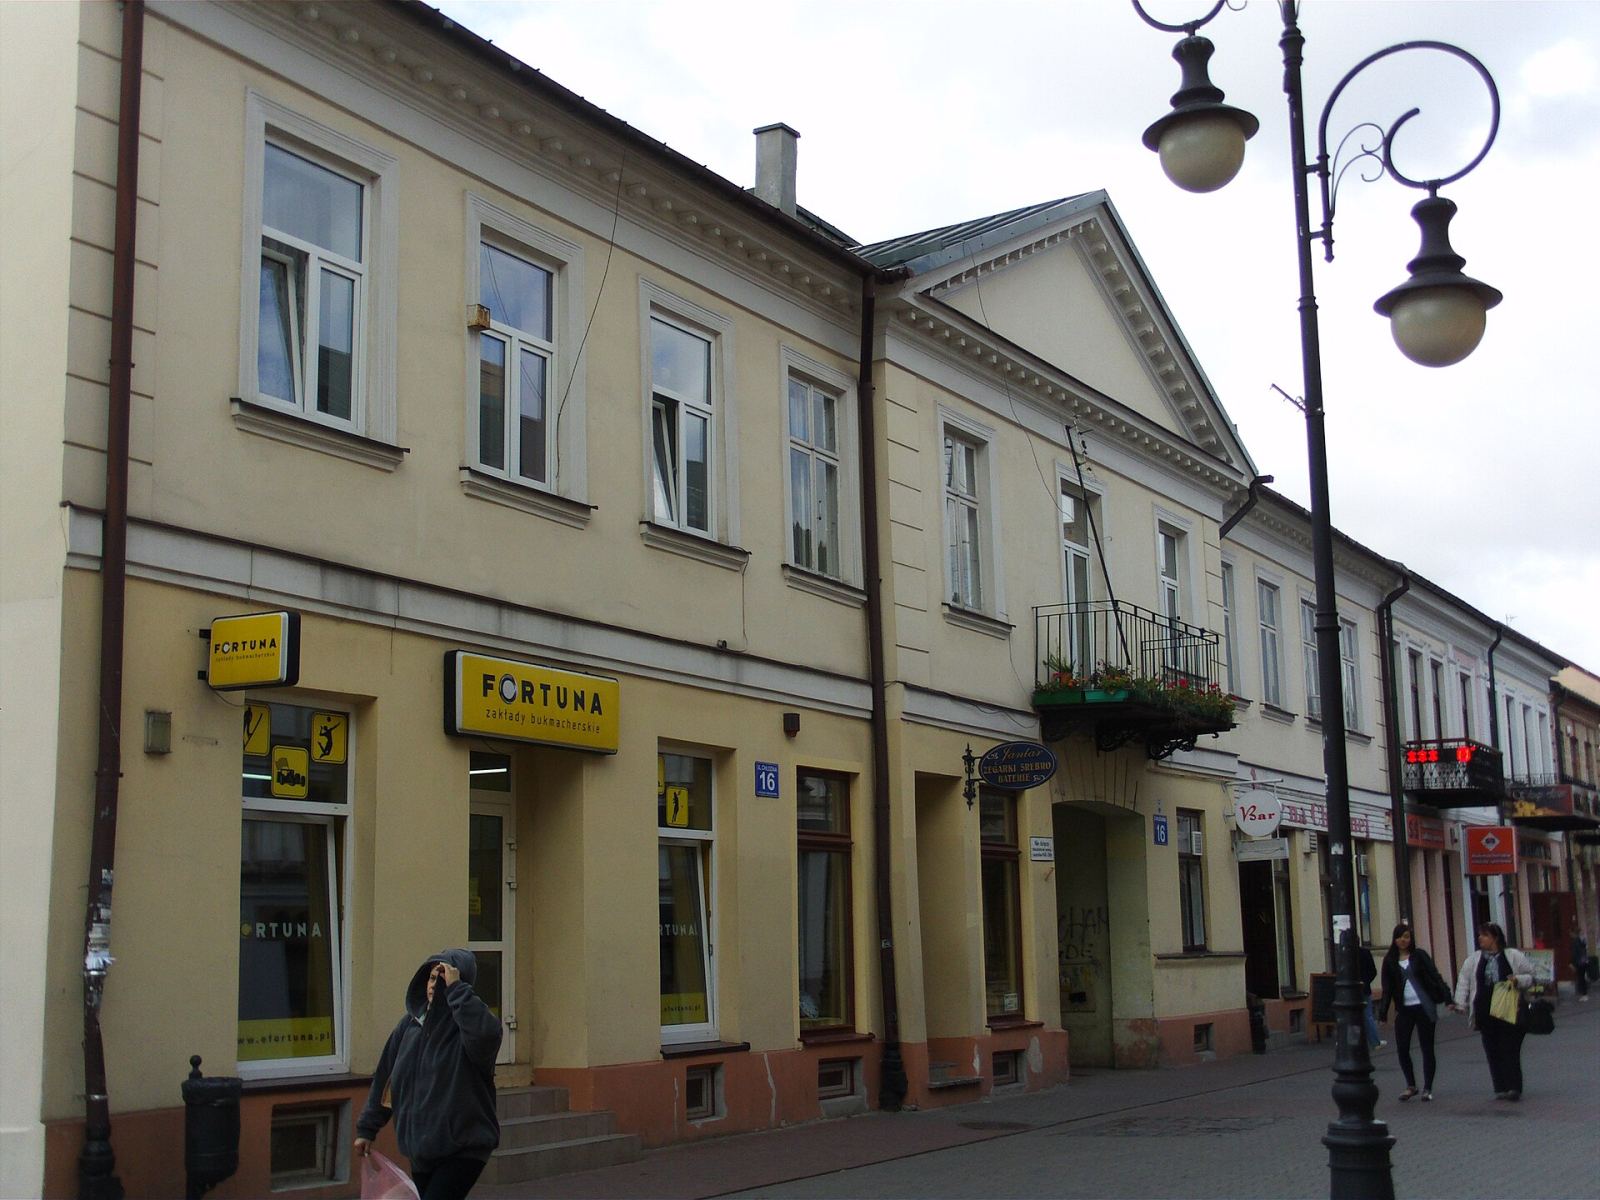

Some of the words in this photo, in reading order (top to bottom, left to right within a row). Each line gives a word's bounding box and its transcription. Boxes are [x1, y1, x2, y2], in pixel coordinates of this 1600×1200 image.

[214, 638, 277, 654] FORTUNA
[482, 673, 603, 716] FORTUNA
[486, 708, 526, 726] zakłady
[531, 712, 600, 734] bukmacherskie
[984, 764, 1016, 775] ZEGARKI
[760, 771, 775, 791] 16
[1240, 804, 1275, 822] Bar
[1157, 823, 1166, 843] 16
